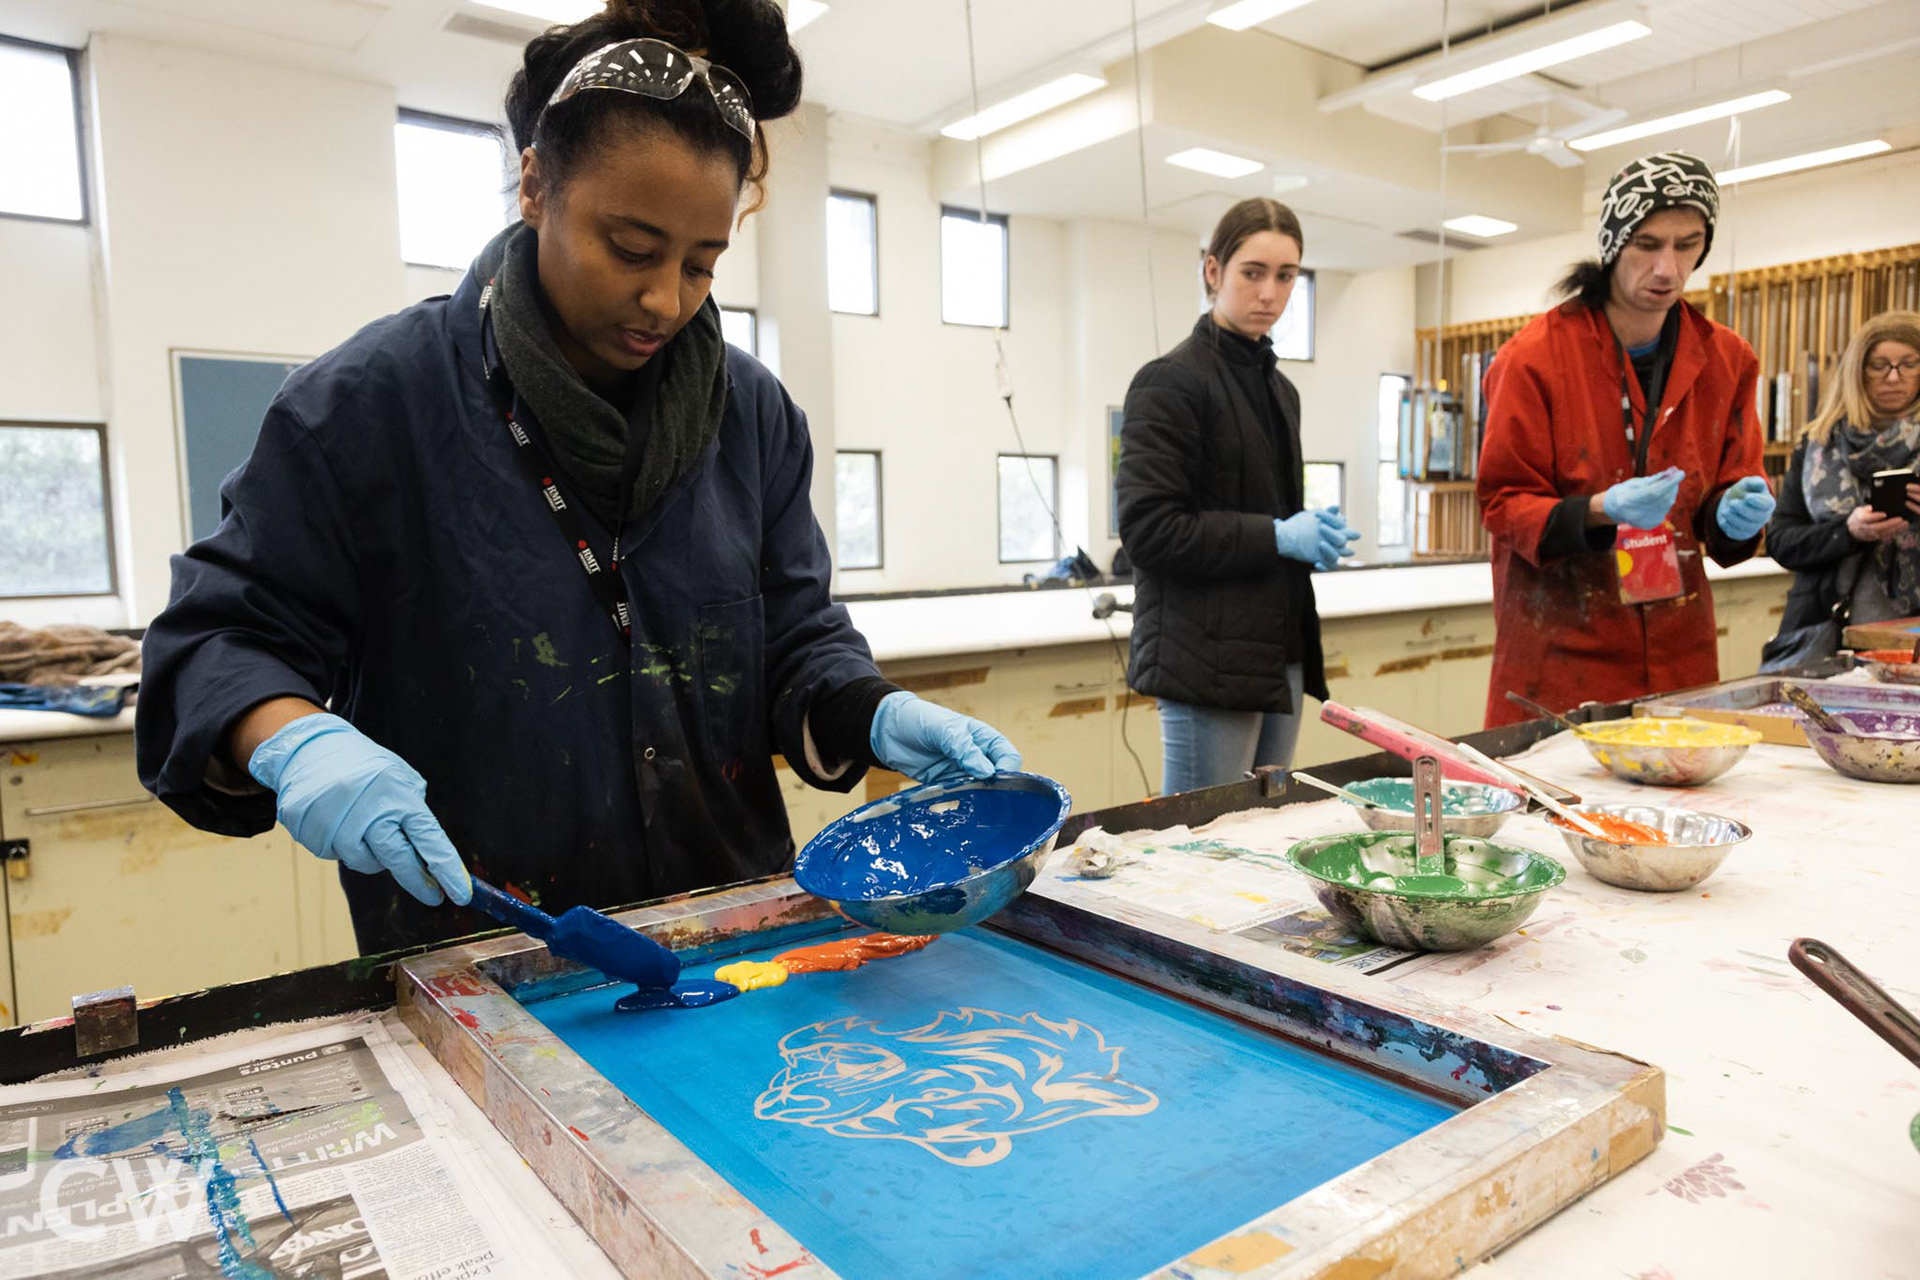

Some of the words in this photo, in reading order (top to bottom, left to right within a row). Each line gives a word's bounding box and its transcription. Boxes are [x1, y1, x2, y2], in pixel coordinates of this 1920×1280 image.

[511, 421, 531, 445] RMIT
[546, 484, 567, 510] RMIT
[1622, 534, 1668, 550] student
[582, 547, 602, 573] RMIT
[616, 601, 631, 627] RMIT
[239, 1050, 318, 1076] punters
[455, 1250, 495, 1271] peak
